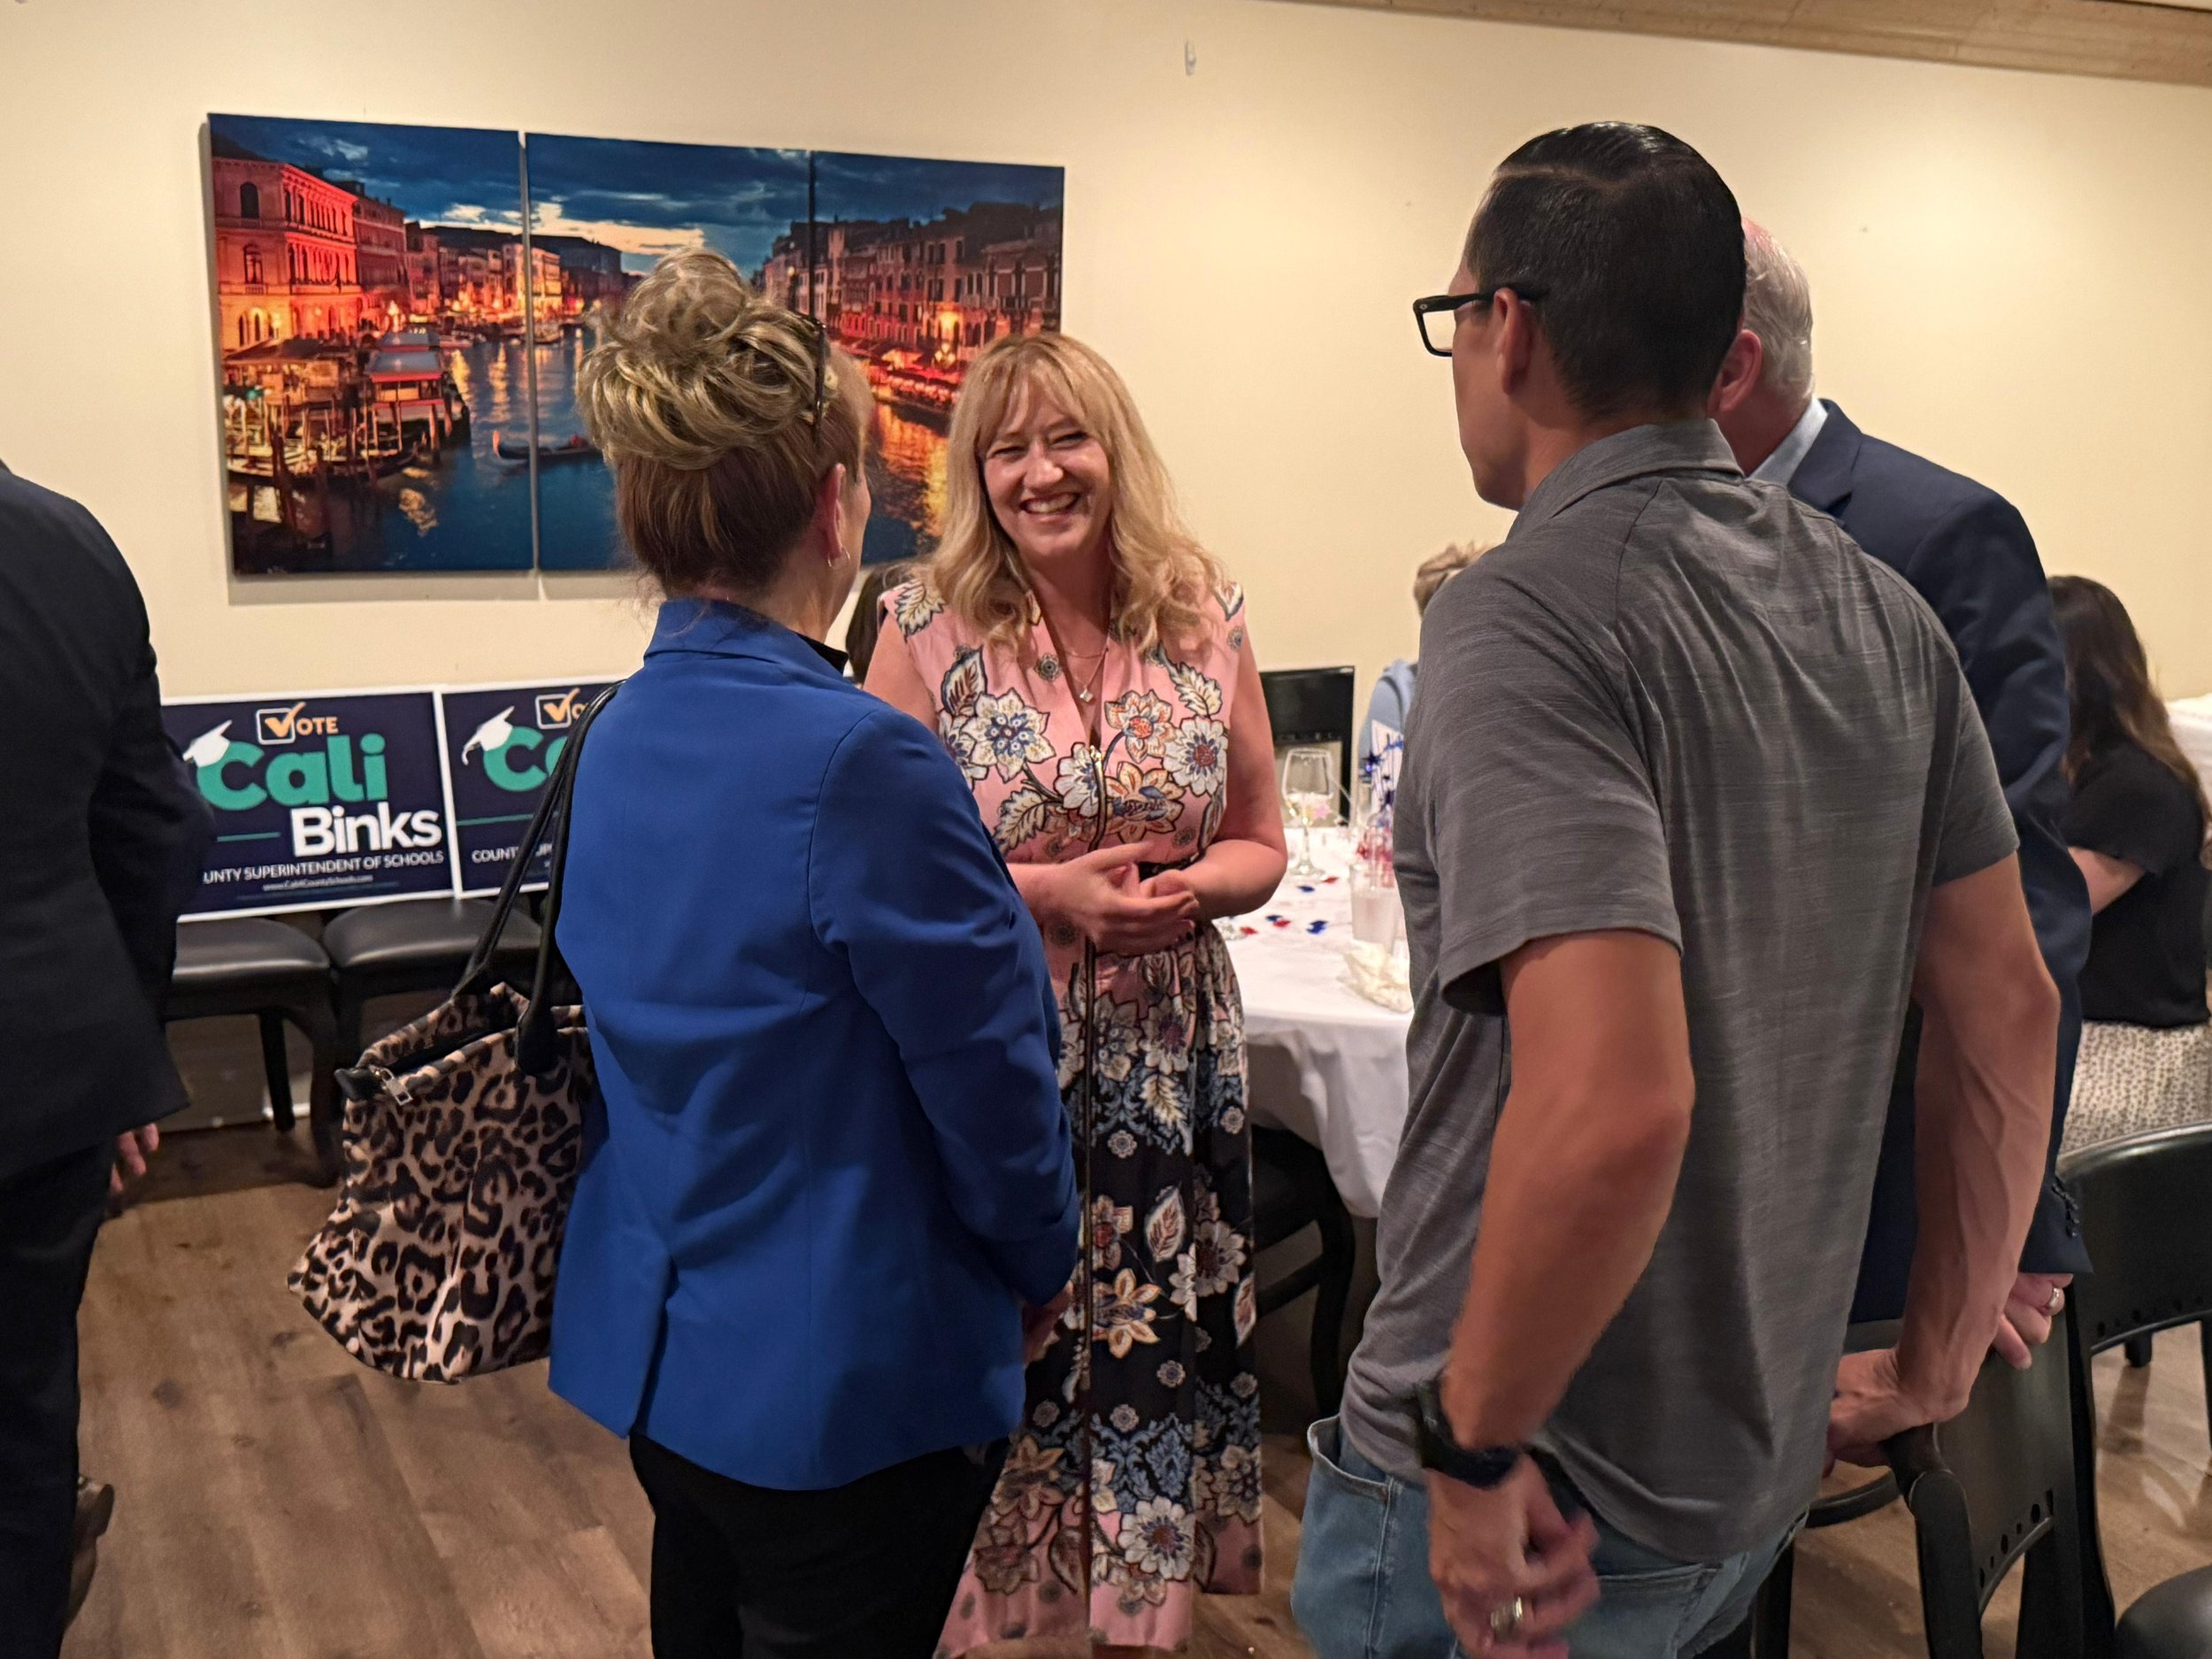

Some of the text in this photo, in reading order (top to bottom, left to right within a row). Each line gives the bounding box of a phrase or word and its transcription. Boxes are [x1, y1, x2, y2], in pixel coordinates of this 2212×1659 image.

[196, 733, 388, 811] Cali
[290, 802, 442, 857] Binks
[203, 867, 242, 884] UNTY
[243, 856, 361, 881] SUPERINTENDENT
[362, 855, 381, 870] OF
[383, 850, 444, 870] SCHOOLS
[471, 846, 519, 864] COUNT
